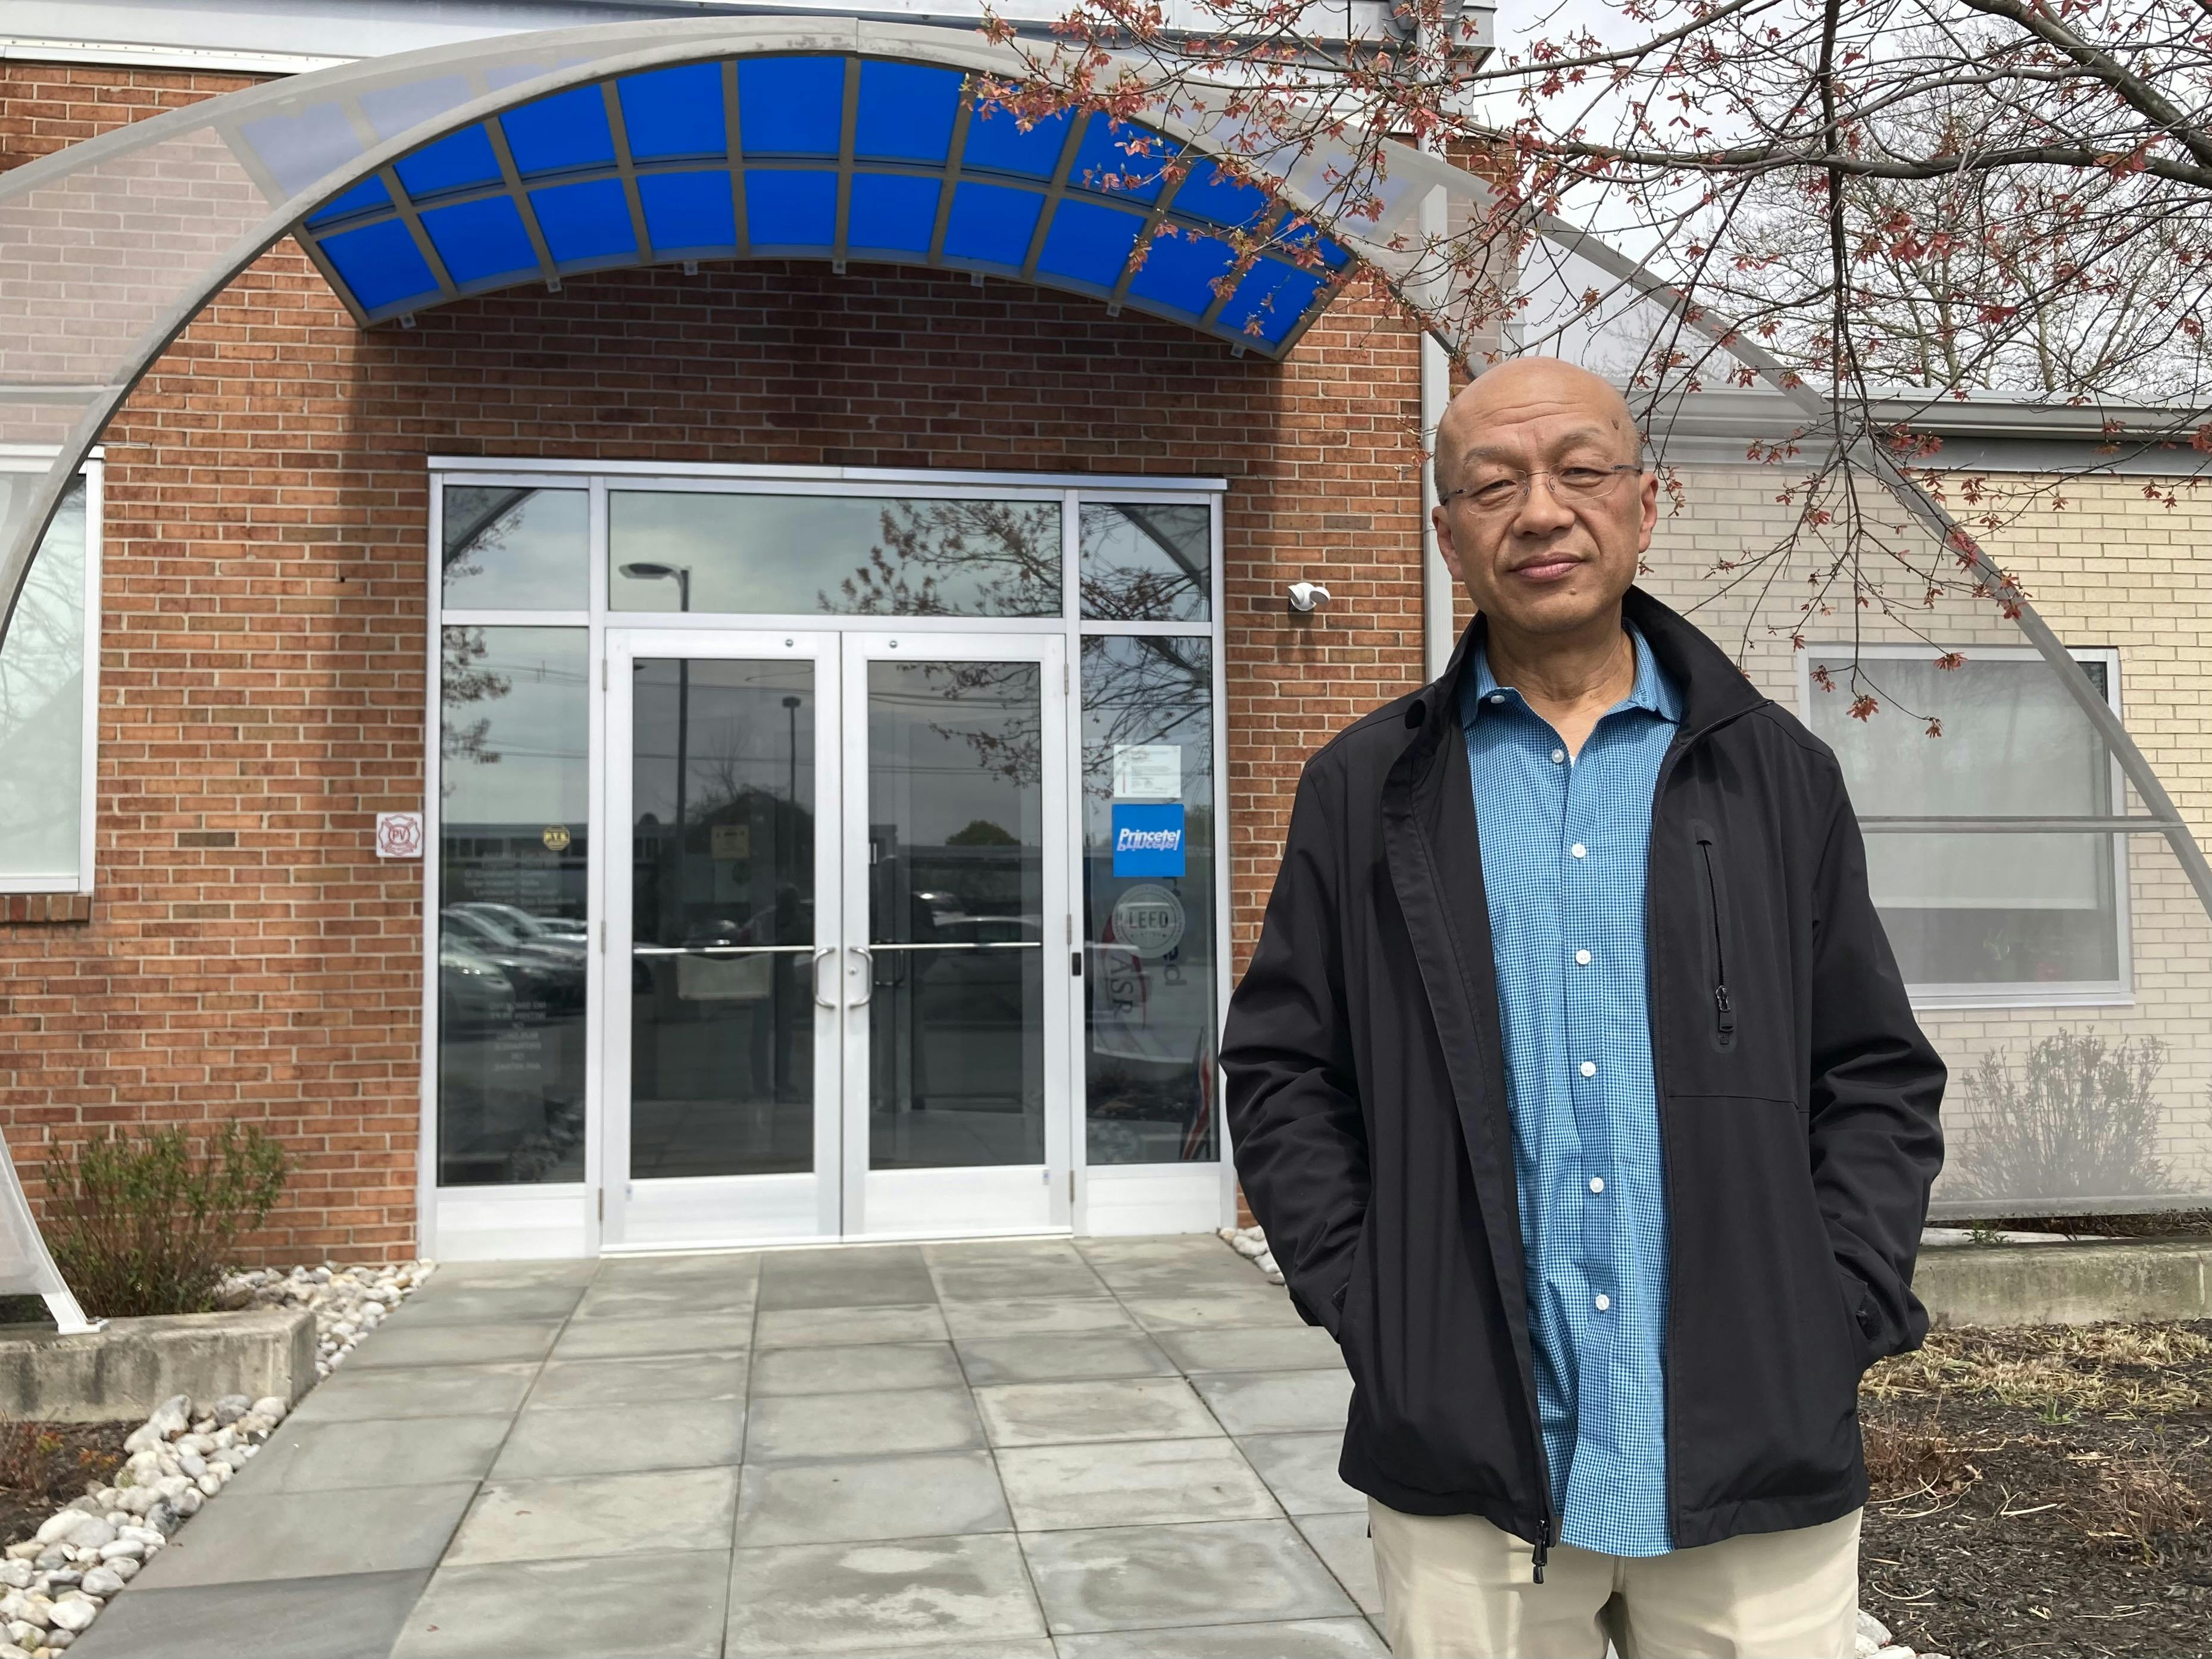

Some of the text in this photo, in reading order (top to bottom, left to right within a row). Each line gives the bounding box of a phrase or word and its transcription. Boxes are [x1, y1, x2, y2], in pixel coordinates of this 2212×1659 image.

[392, 829, 406, 840] PV
[1119, 828, 1181, 842] Princetel
[1129, 911, 1169, 929] LEED
